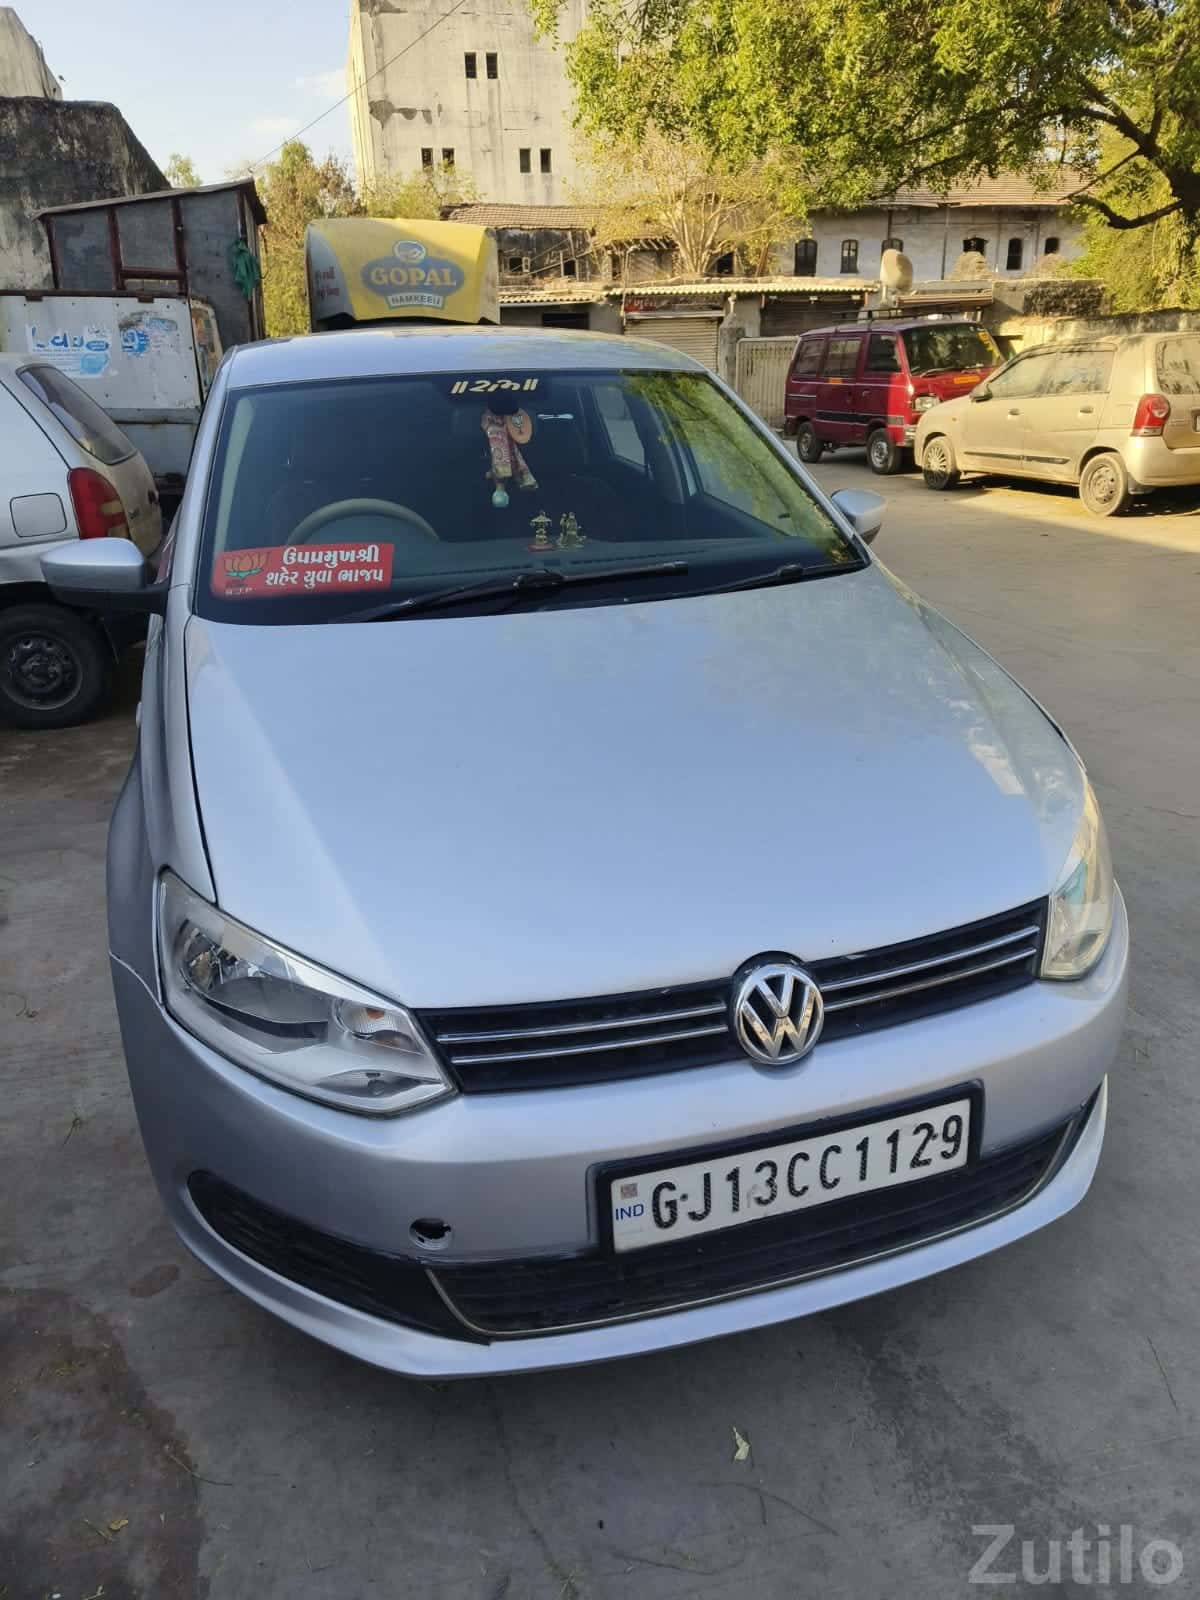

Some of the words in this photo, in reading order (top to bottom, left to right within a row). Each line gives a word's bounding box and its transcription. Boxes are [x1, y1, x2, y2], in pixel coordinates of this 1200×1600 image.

[370, 267, 456, 287] GOPAL
[282, 544, 380, 568] ઉપપ્રમુખશ્રી
[265, 567, 299, 586] શહેર
[303, 569, 332, 589] યુવા
[337, 567, 384, 583] ભાજપ
[651, 1113, 963, 1229] GJ13CC1129
[615, 1203, 645, 1221] IND
